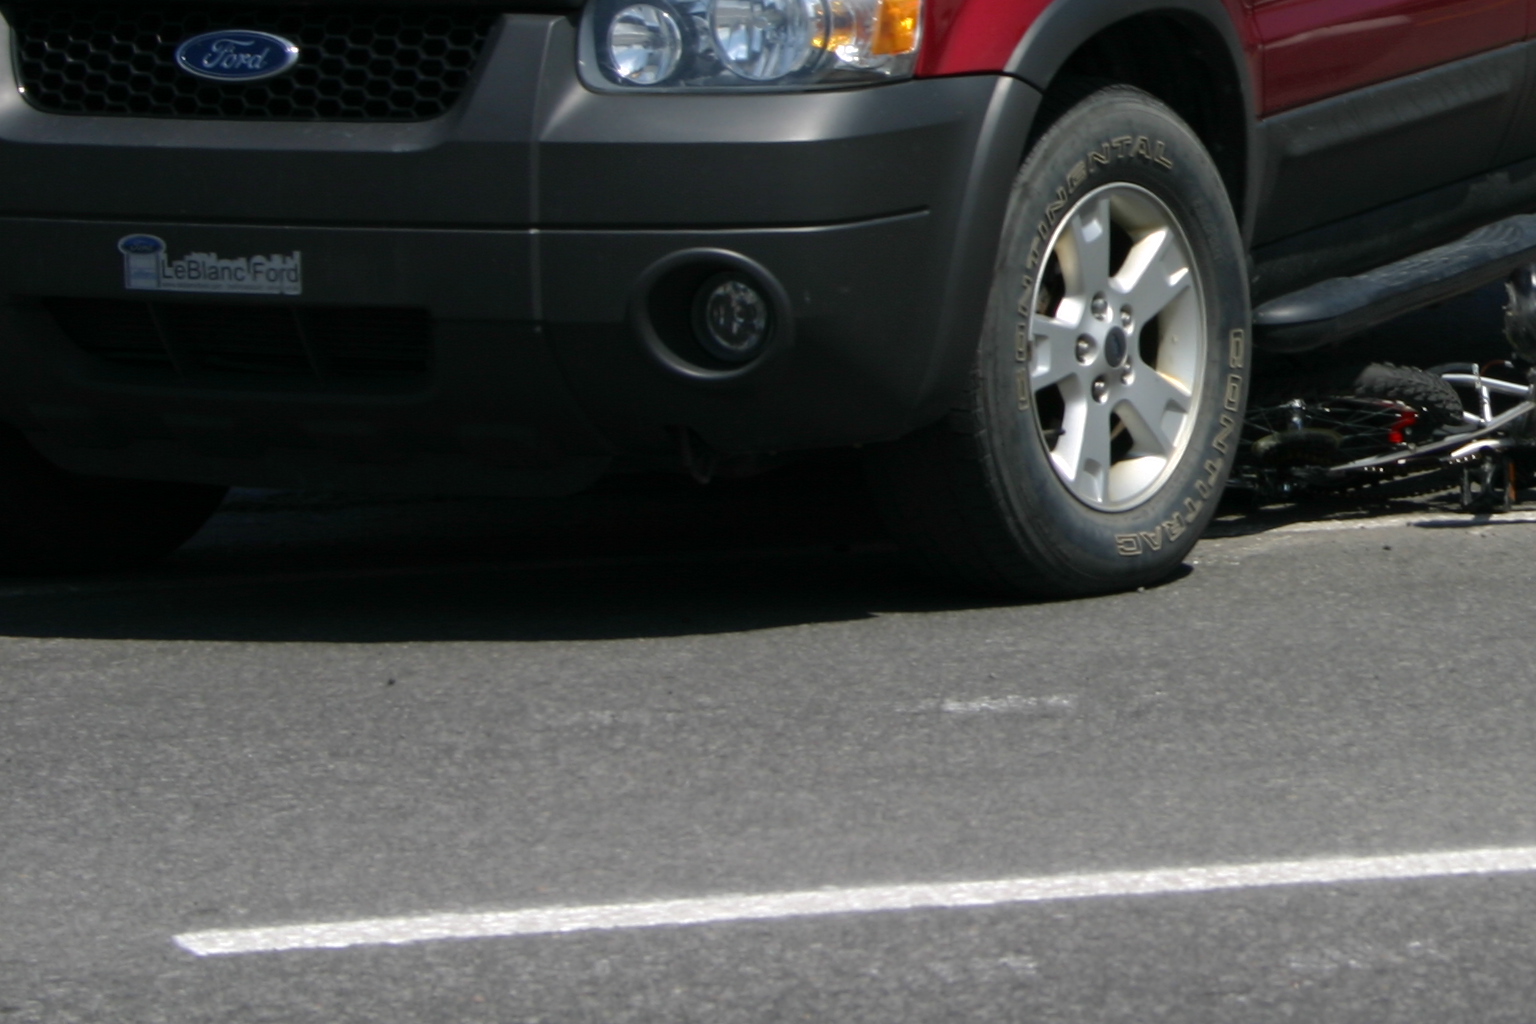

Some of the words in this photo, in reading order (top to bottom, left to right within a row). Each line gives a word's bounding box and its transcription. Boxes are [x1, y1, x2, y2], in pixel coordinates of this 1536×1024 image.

[202, 38, 270, 69] Ford
[161, 259, 246, 281] LeBlanc
[253, 261, 299, 283] Ford
[1015, 134, 1174, 411] CONTINENTAL
[1117, 328, 1245, 558] CONTITRAC
